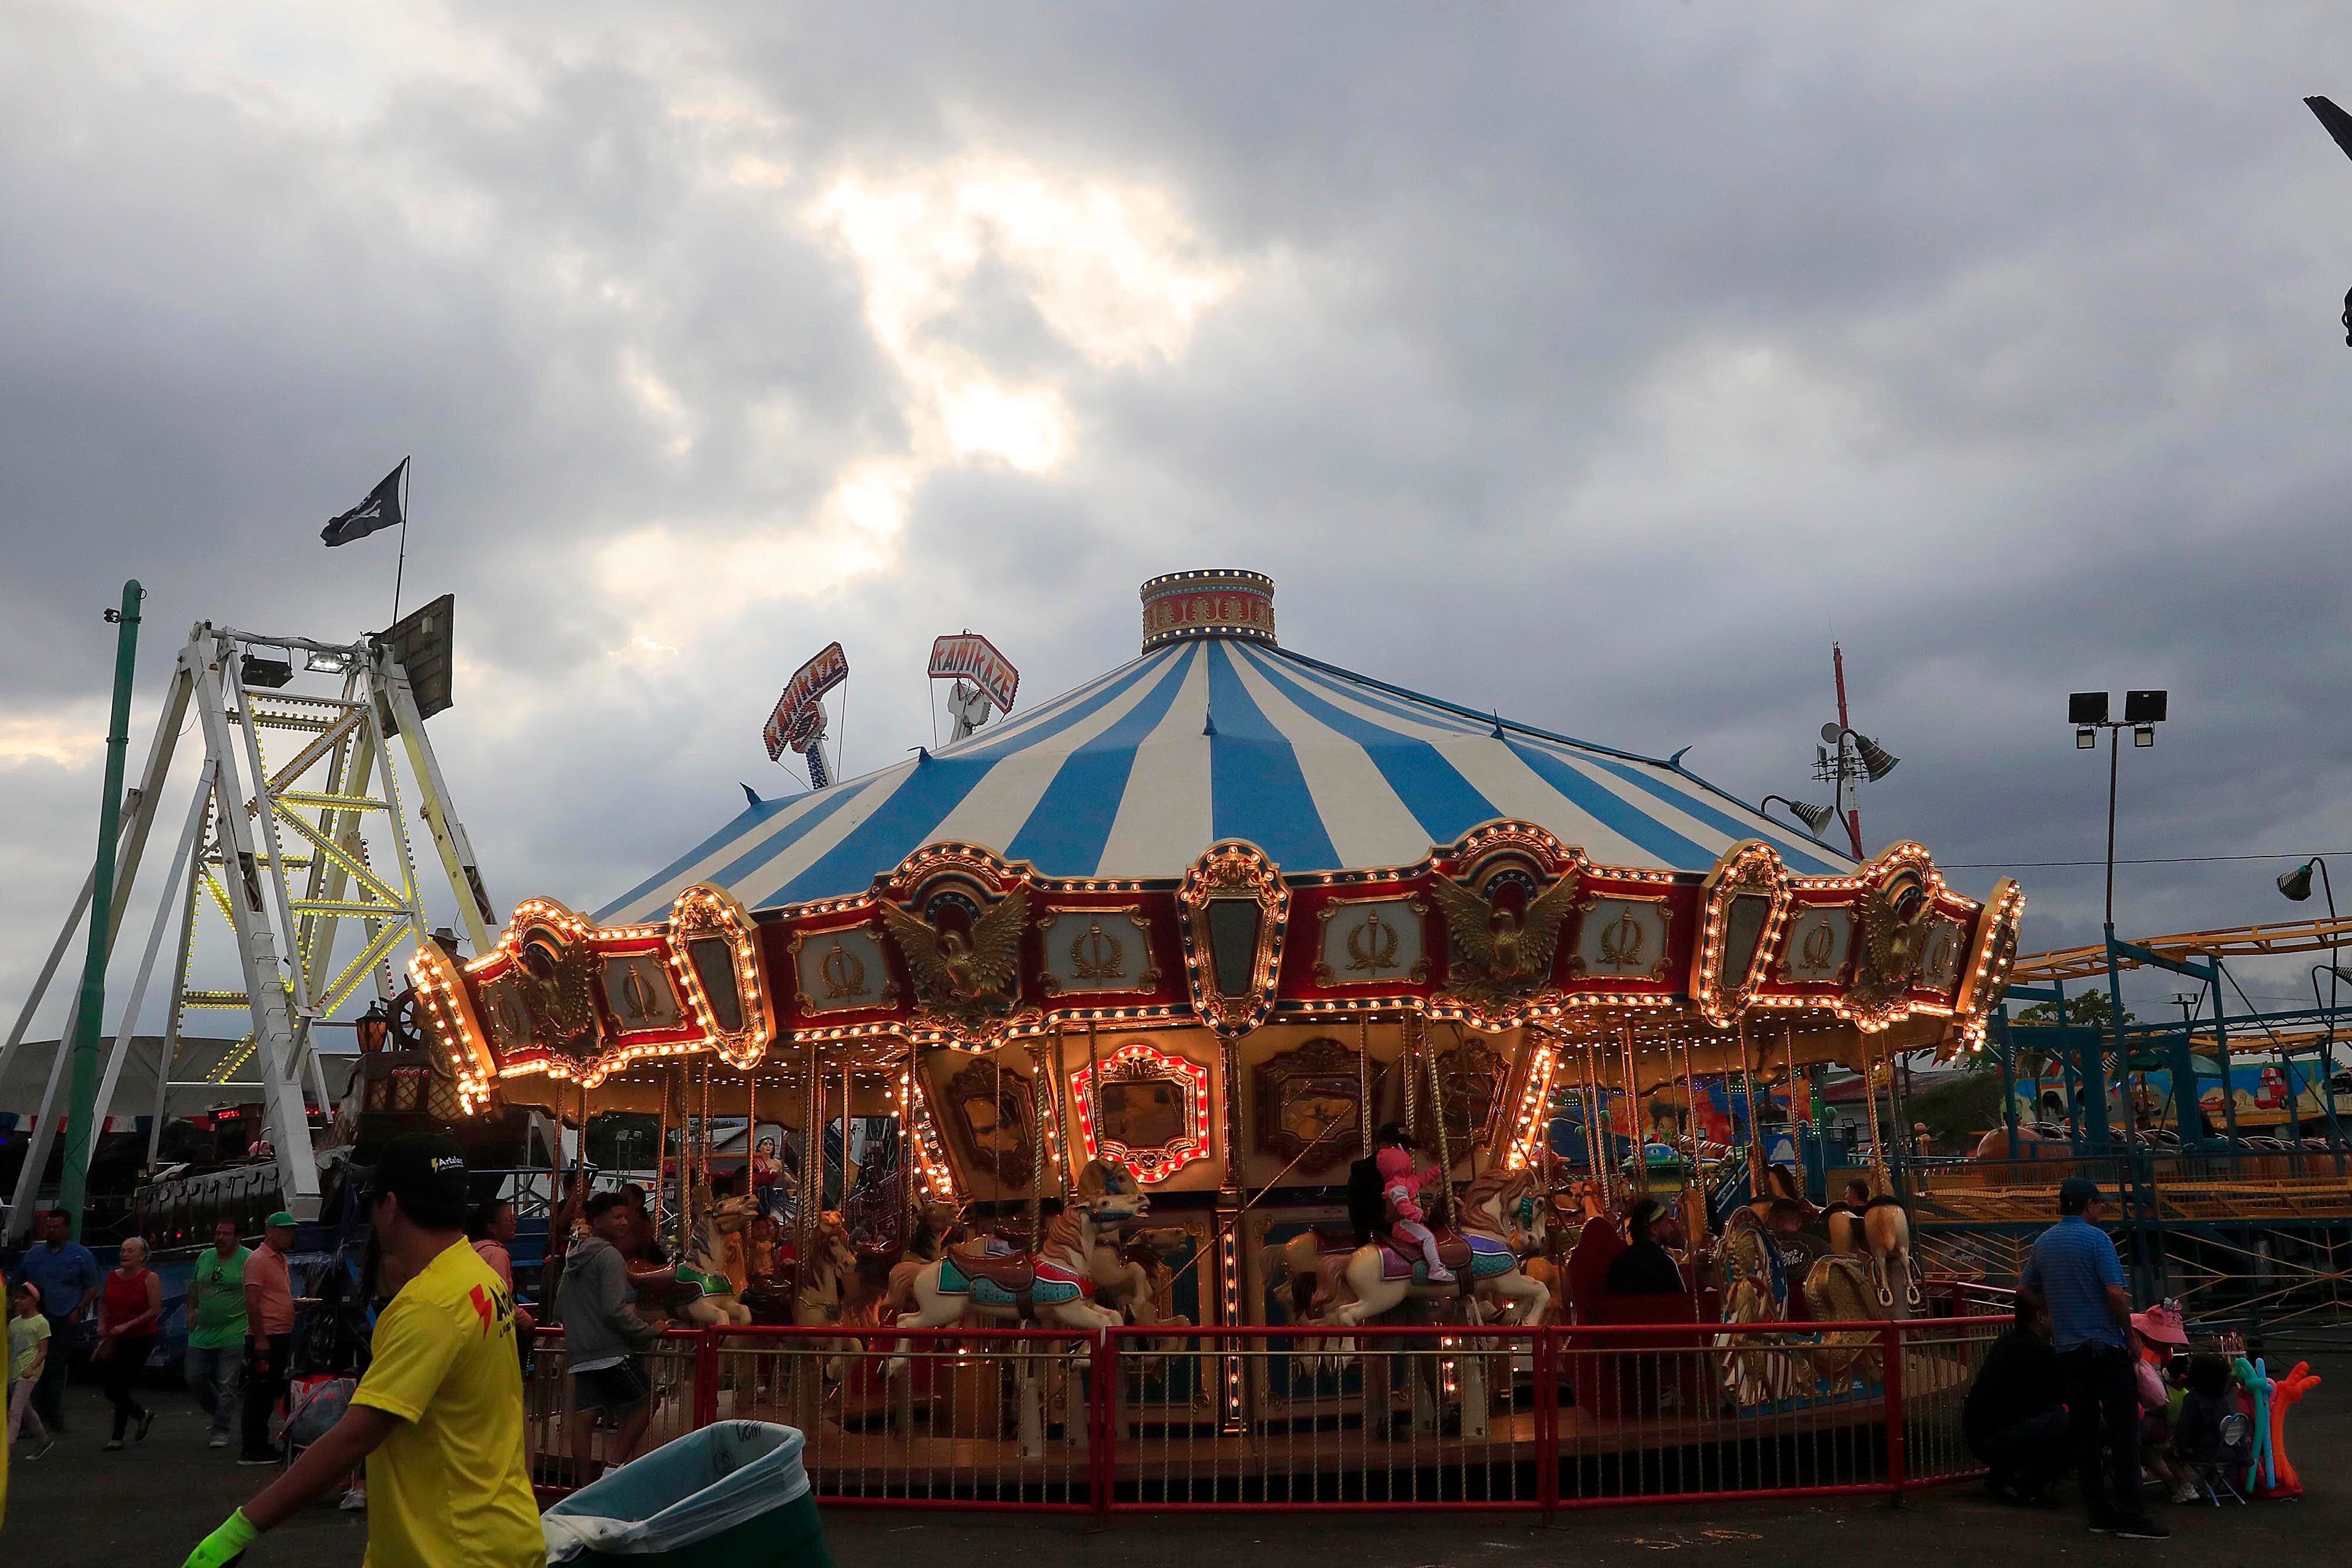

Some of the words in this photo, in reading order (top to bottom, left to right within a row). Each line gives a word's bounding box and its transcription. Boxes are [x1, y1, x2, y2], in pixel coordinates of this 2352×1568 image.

[765, 647, 845, 756] KAMIKAZE
[931, 641, 1014, 707] KAMIKAZE
[1783, 1252, 1804, 1266] Me!
